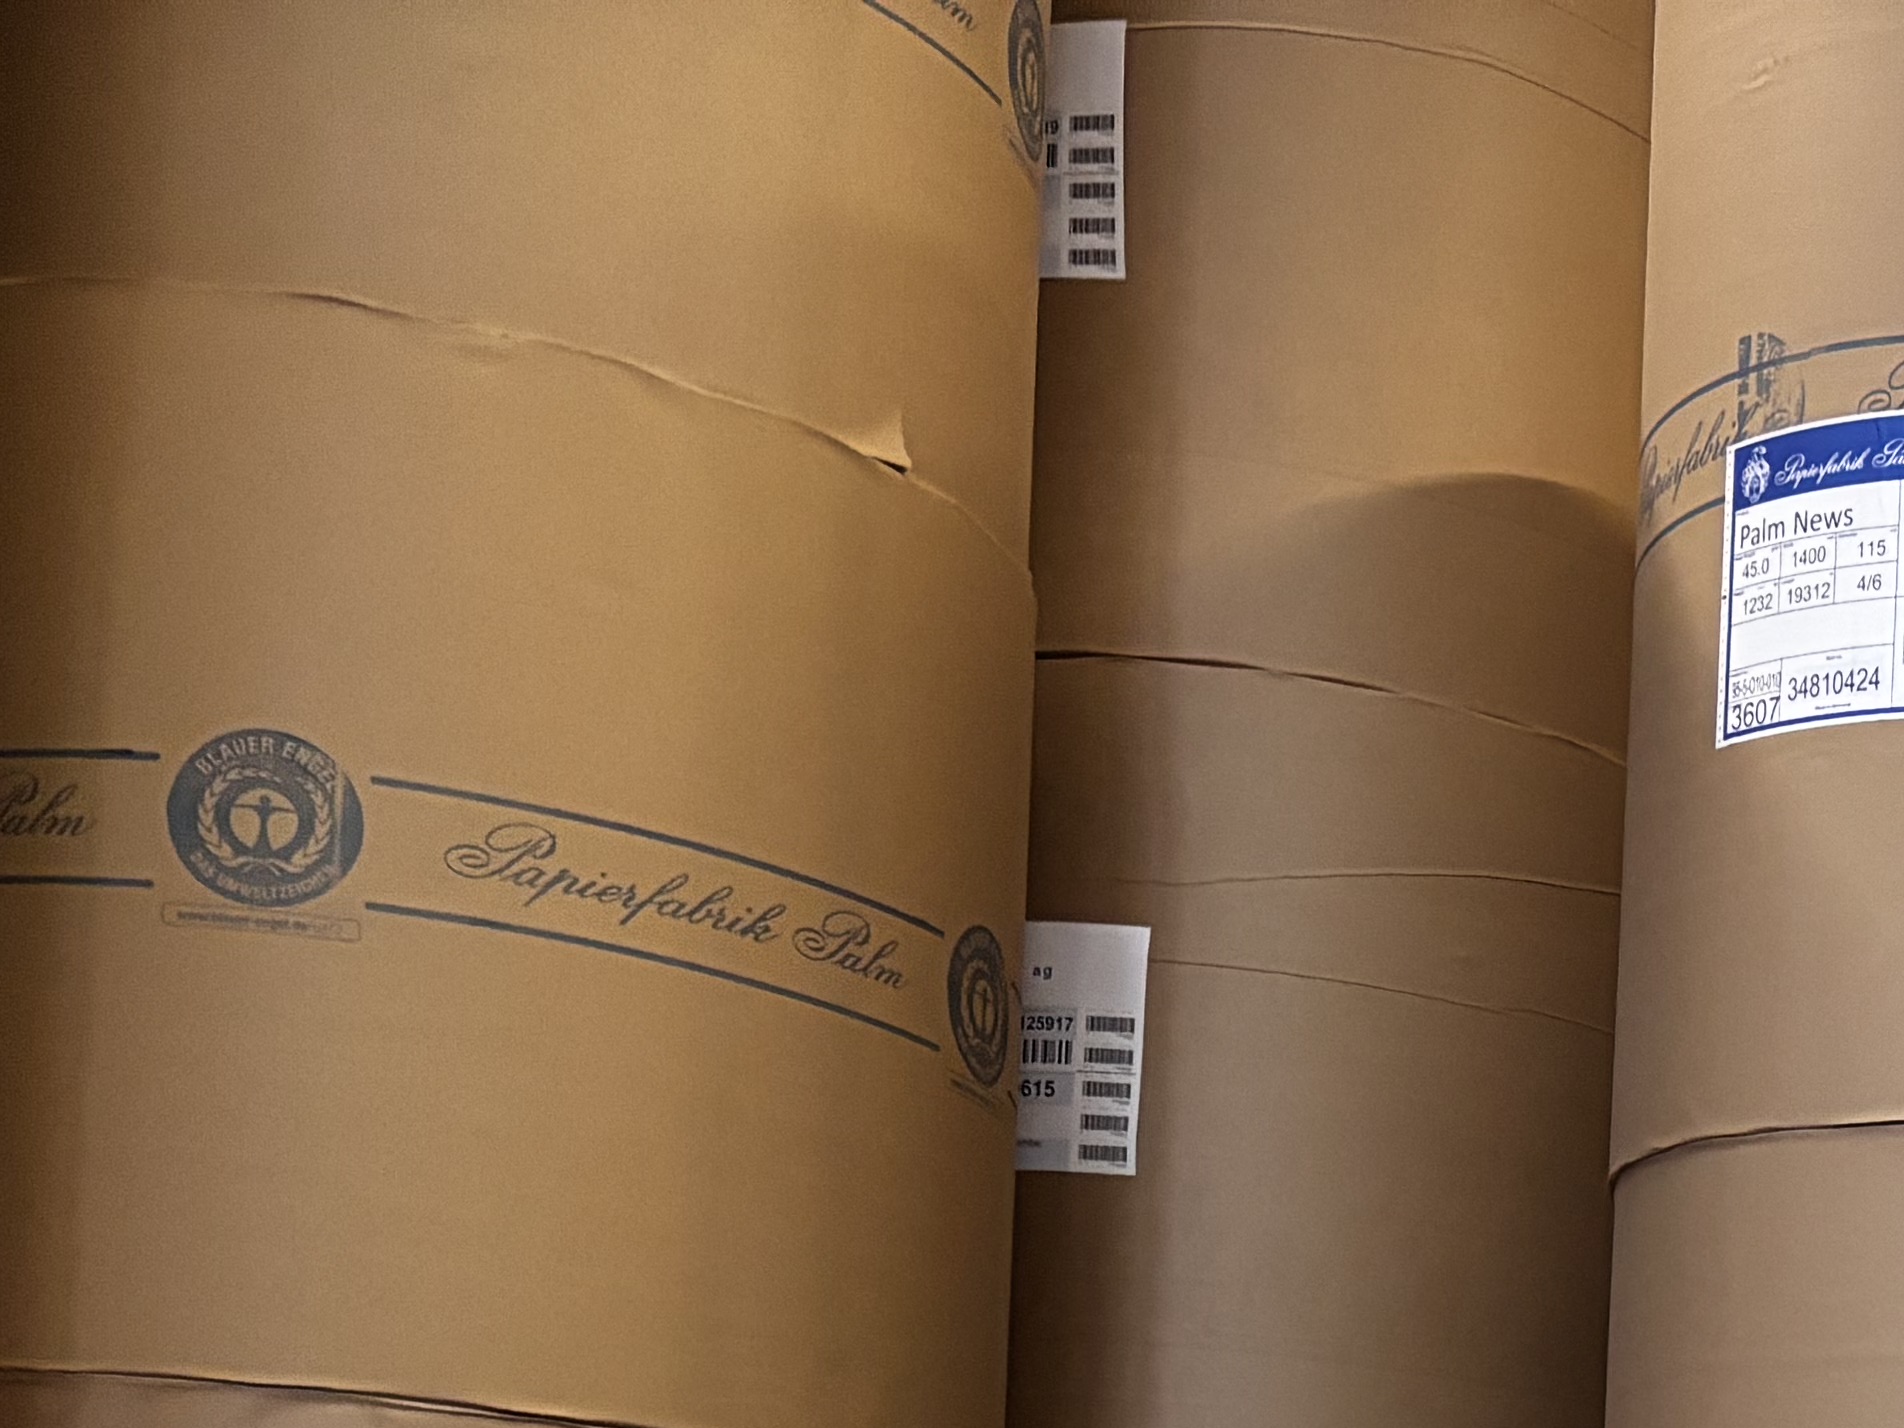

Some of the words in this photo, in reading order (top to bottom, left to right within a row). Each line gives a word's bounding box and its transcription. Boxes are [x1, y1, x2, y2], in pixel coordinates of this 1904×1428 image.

[1774, 448, 1871, 490] Papierfabrik
[1740, 517, 1785, 549] Palm
[1793, 508, 1854, 535] News
[1743, 557, 1770, 581] 45.0
[1792, 545, 1826, 567] 1400
[1858, 540, 1887, 558] 115
[1743, 593, 1773, 615] 1232
[1787, 582, 1831, 605] 19312
[1857, 574, 1882, 591] 4/6
[1787, 666, 1880, 701] 34810424
[1731, 696, 1780, 730] 3607
[197, 735, 273, 776] BLAUER
[281, 740, 337, 792] ENGEL
[444, 822, 787, 926] Papierfabrik
[792, 911, 905, 990] Palm
[1032, 965, 1053, 980] ag
